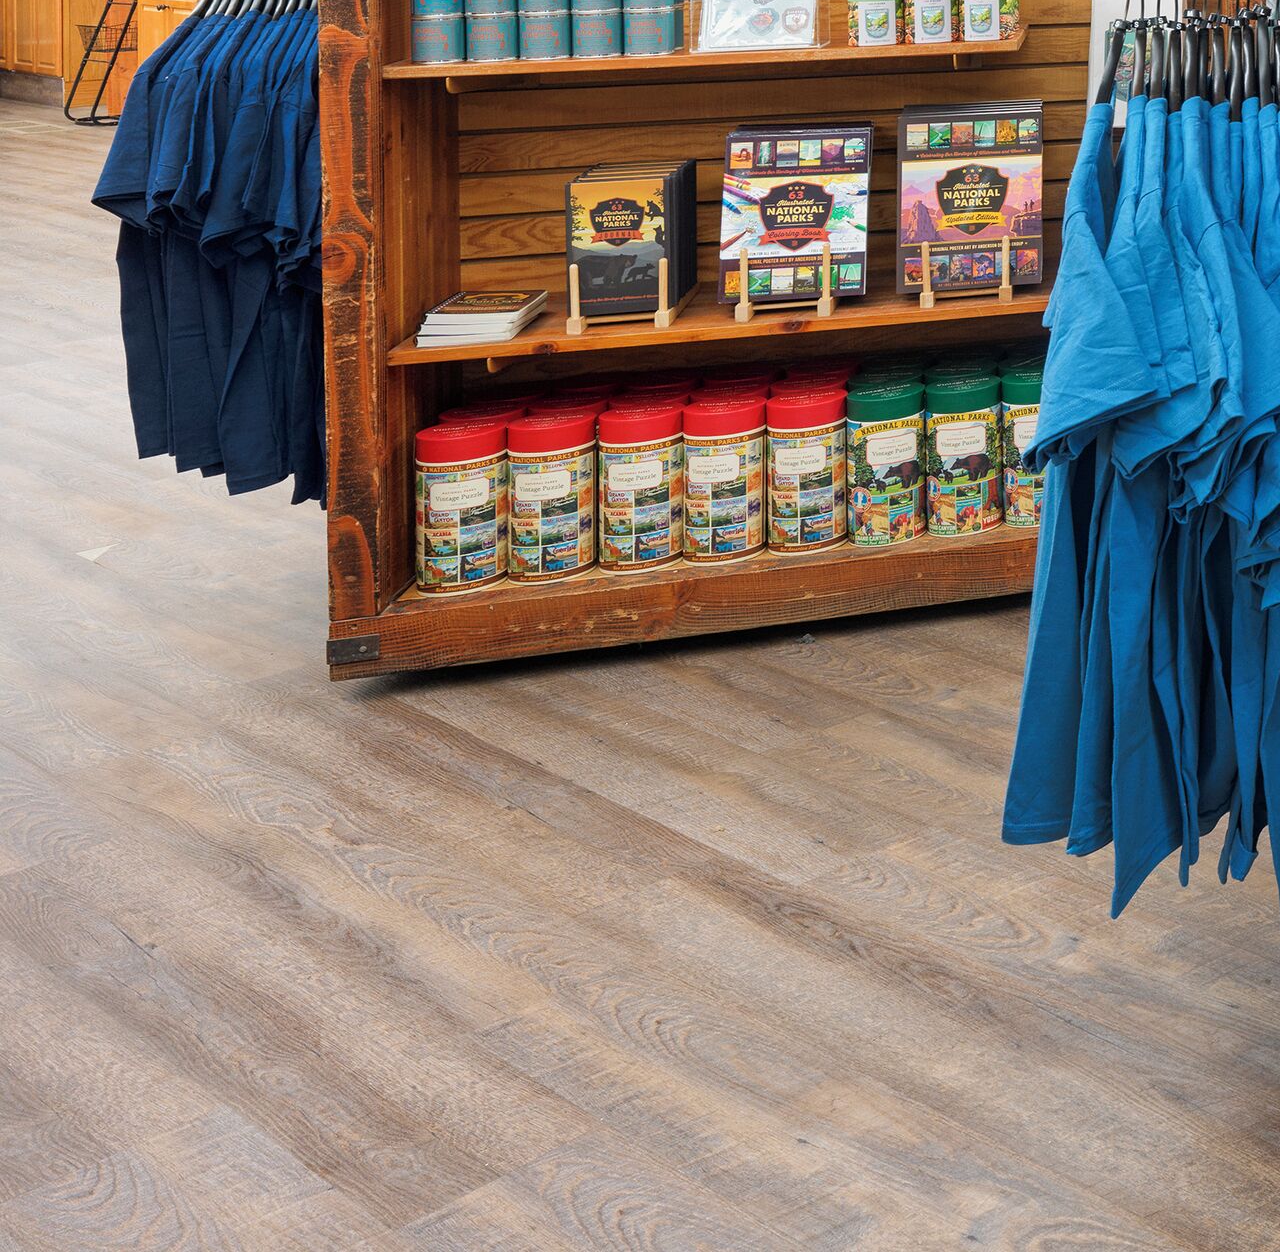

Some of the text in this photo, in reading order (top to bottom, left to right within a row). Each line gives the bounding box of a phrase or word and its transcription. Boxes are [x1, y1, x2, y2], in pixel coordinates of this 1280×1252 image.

[953, 182, 990, 190] Illustrated
[789, 191, 804, 199] 63
[944, 189, 1000, 199] NATIONAL
[777, 199, 814, 207] Illustrated
[954, 198, 990, 207] PARKS
[767, 206, 824, 215] NATIONAL
[777, 214, 814, 223] PARKS
[945, 215, 973, 223] Updated
[768, 230, 800, 238] Coloring
[861, 420, 920, 435] NATIONAL PARKS
[429, 461, 490, 473] NATIONAL PARKS
[435, 491, 483, 503] Vintage Puzzle
